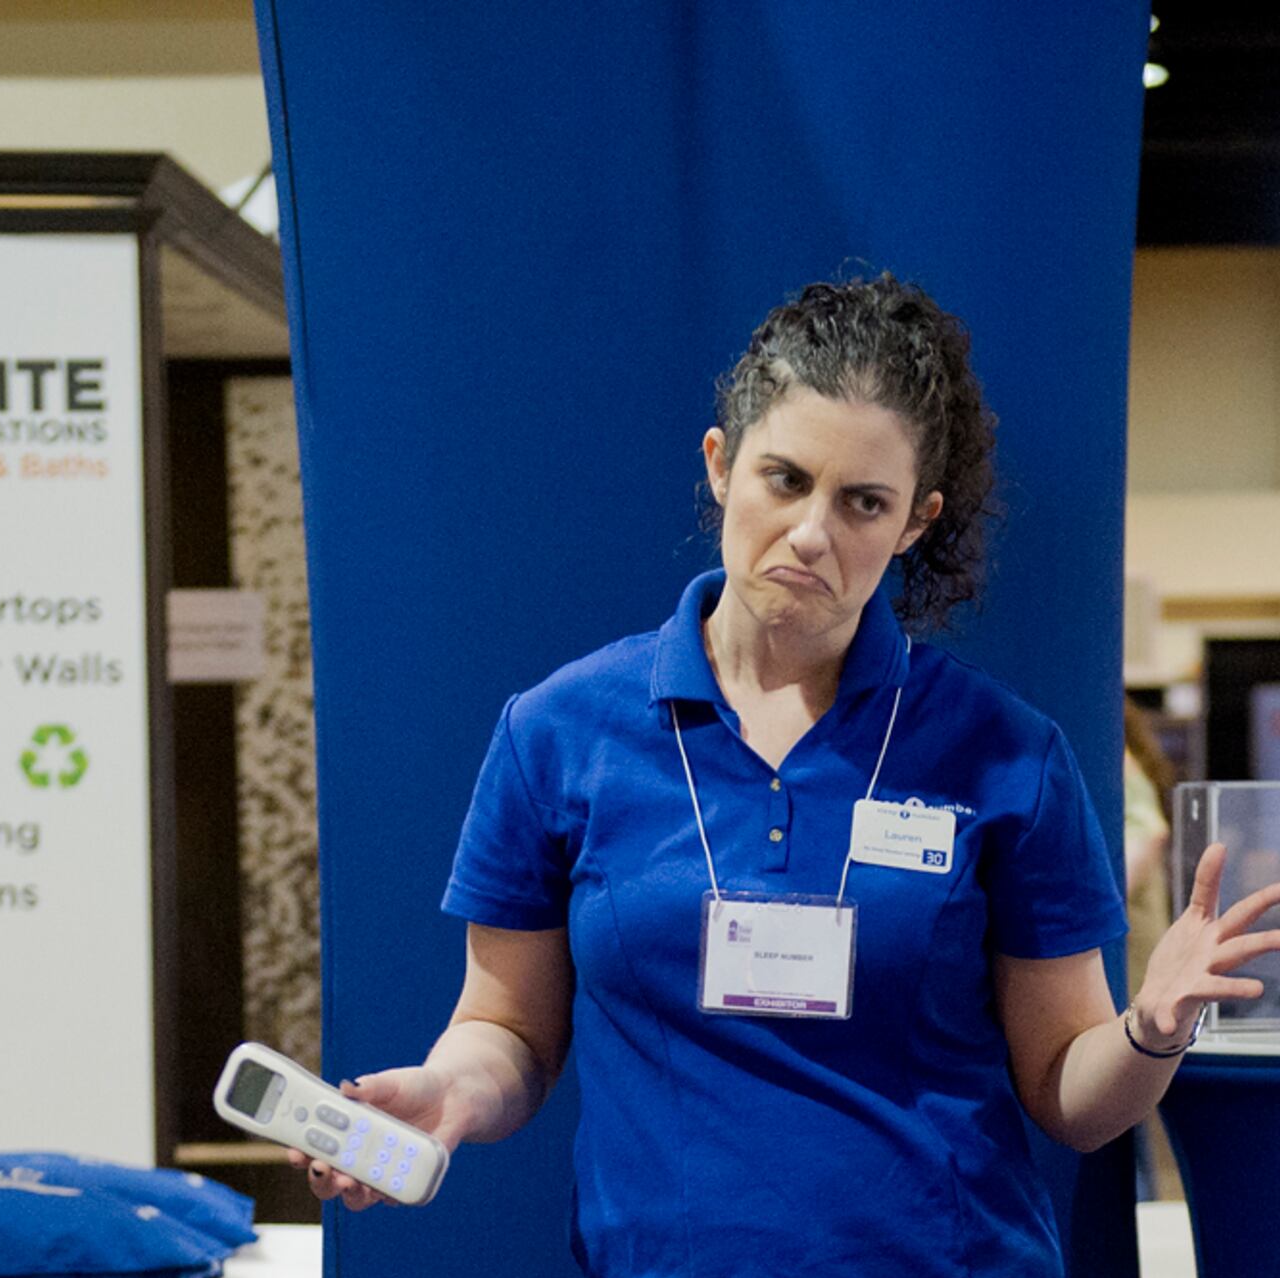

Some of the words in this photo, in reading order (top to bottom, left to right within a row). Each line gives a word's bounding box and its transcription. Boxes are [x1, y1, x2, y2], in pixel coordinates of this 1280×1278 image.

[20, 454, 109, 480] Baths
[17, 653, 125, 686] Walls
[926, 851, 943, 865] 30
